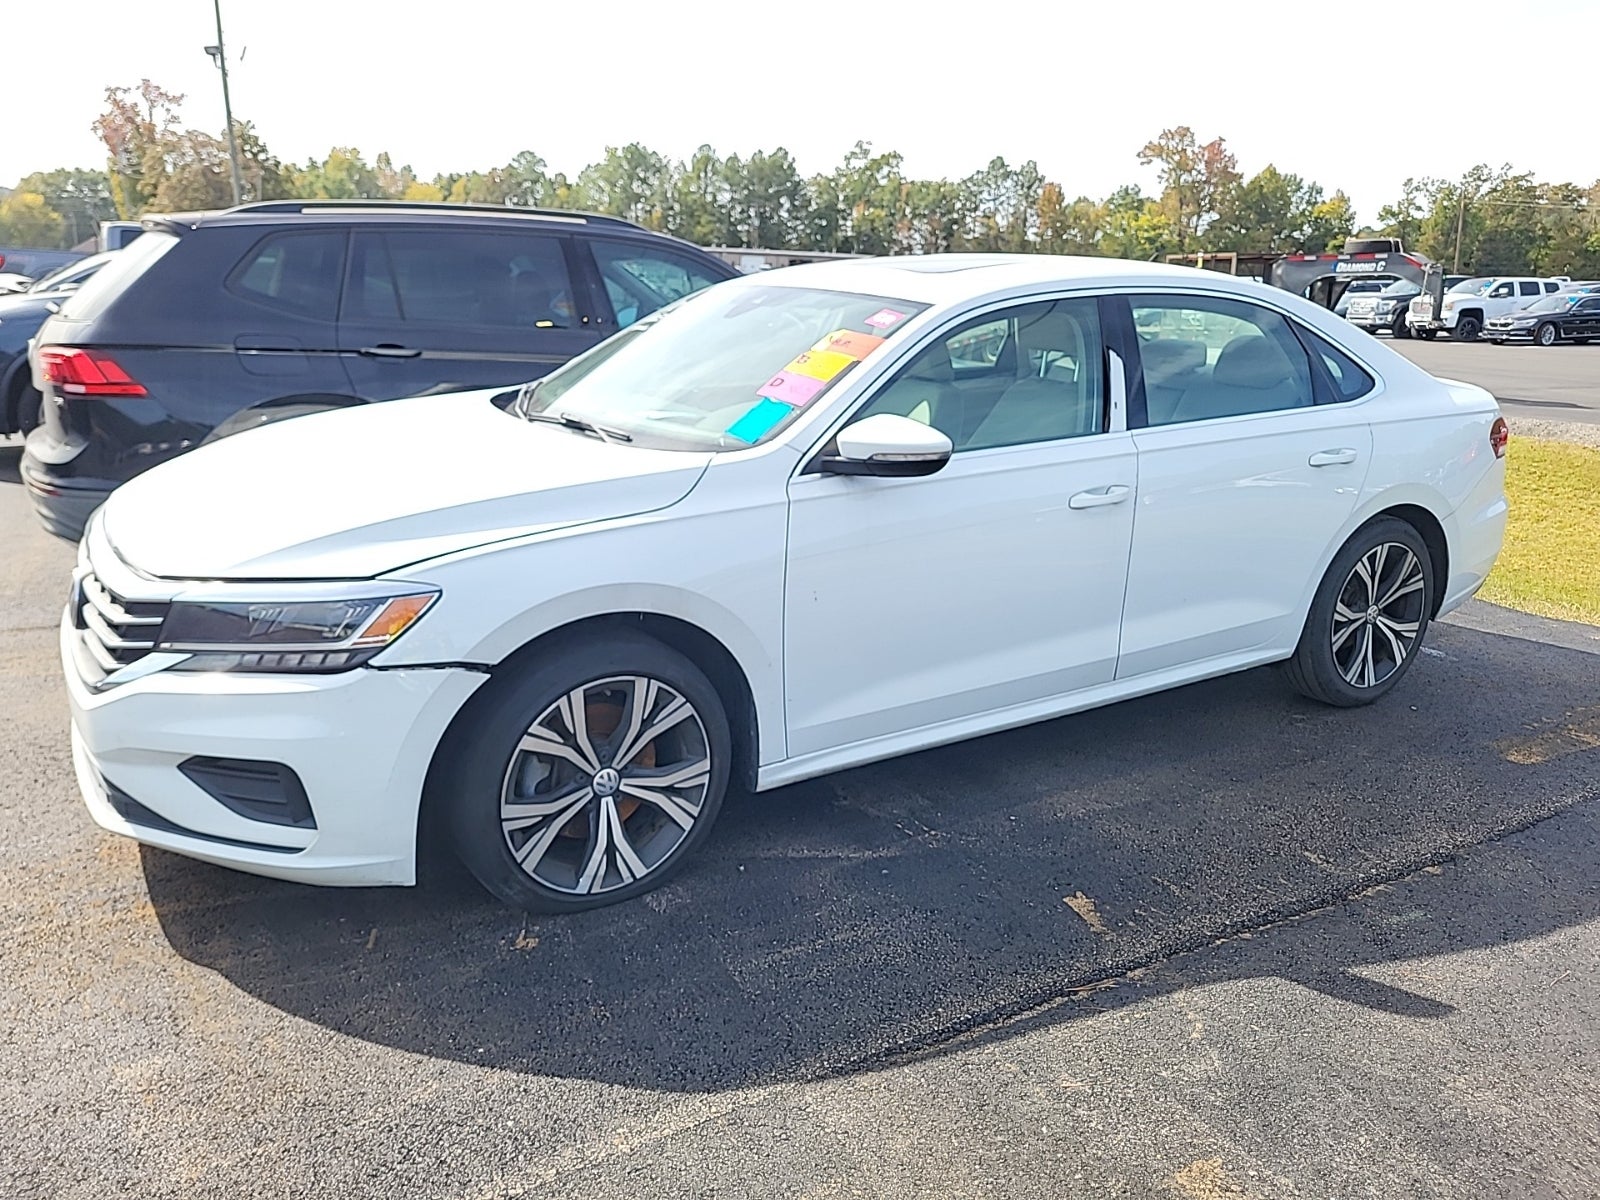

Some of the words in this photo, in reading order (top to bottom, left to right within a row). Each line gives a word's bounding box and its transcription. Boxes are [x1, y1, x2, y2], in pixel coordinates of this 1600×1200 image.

[1335, 262, 1376, 272] DIAMOND
[1376, 261, 1386, 271] C
[770, 378, 784, 386] D
